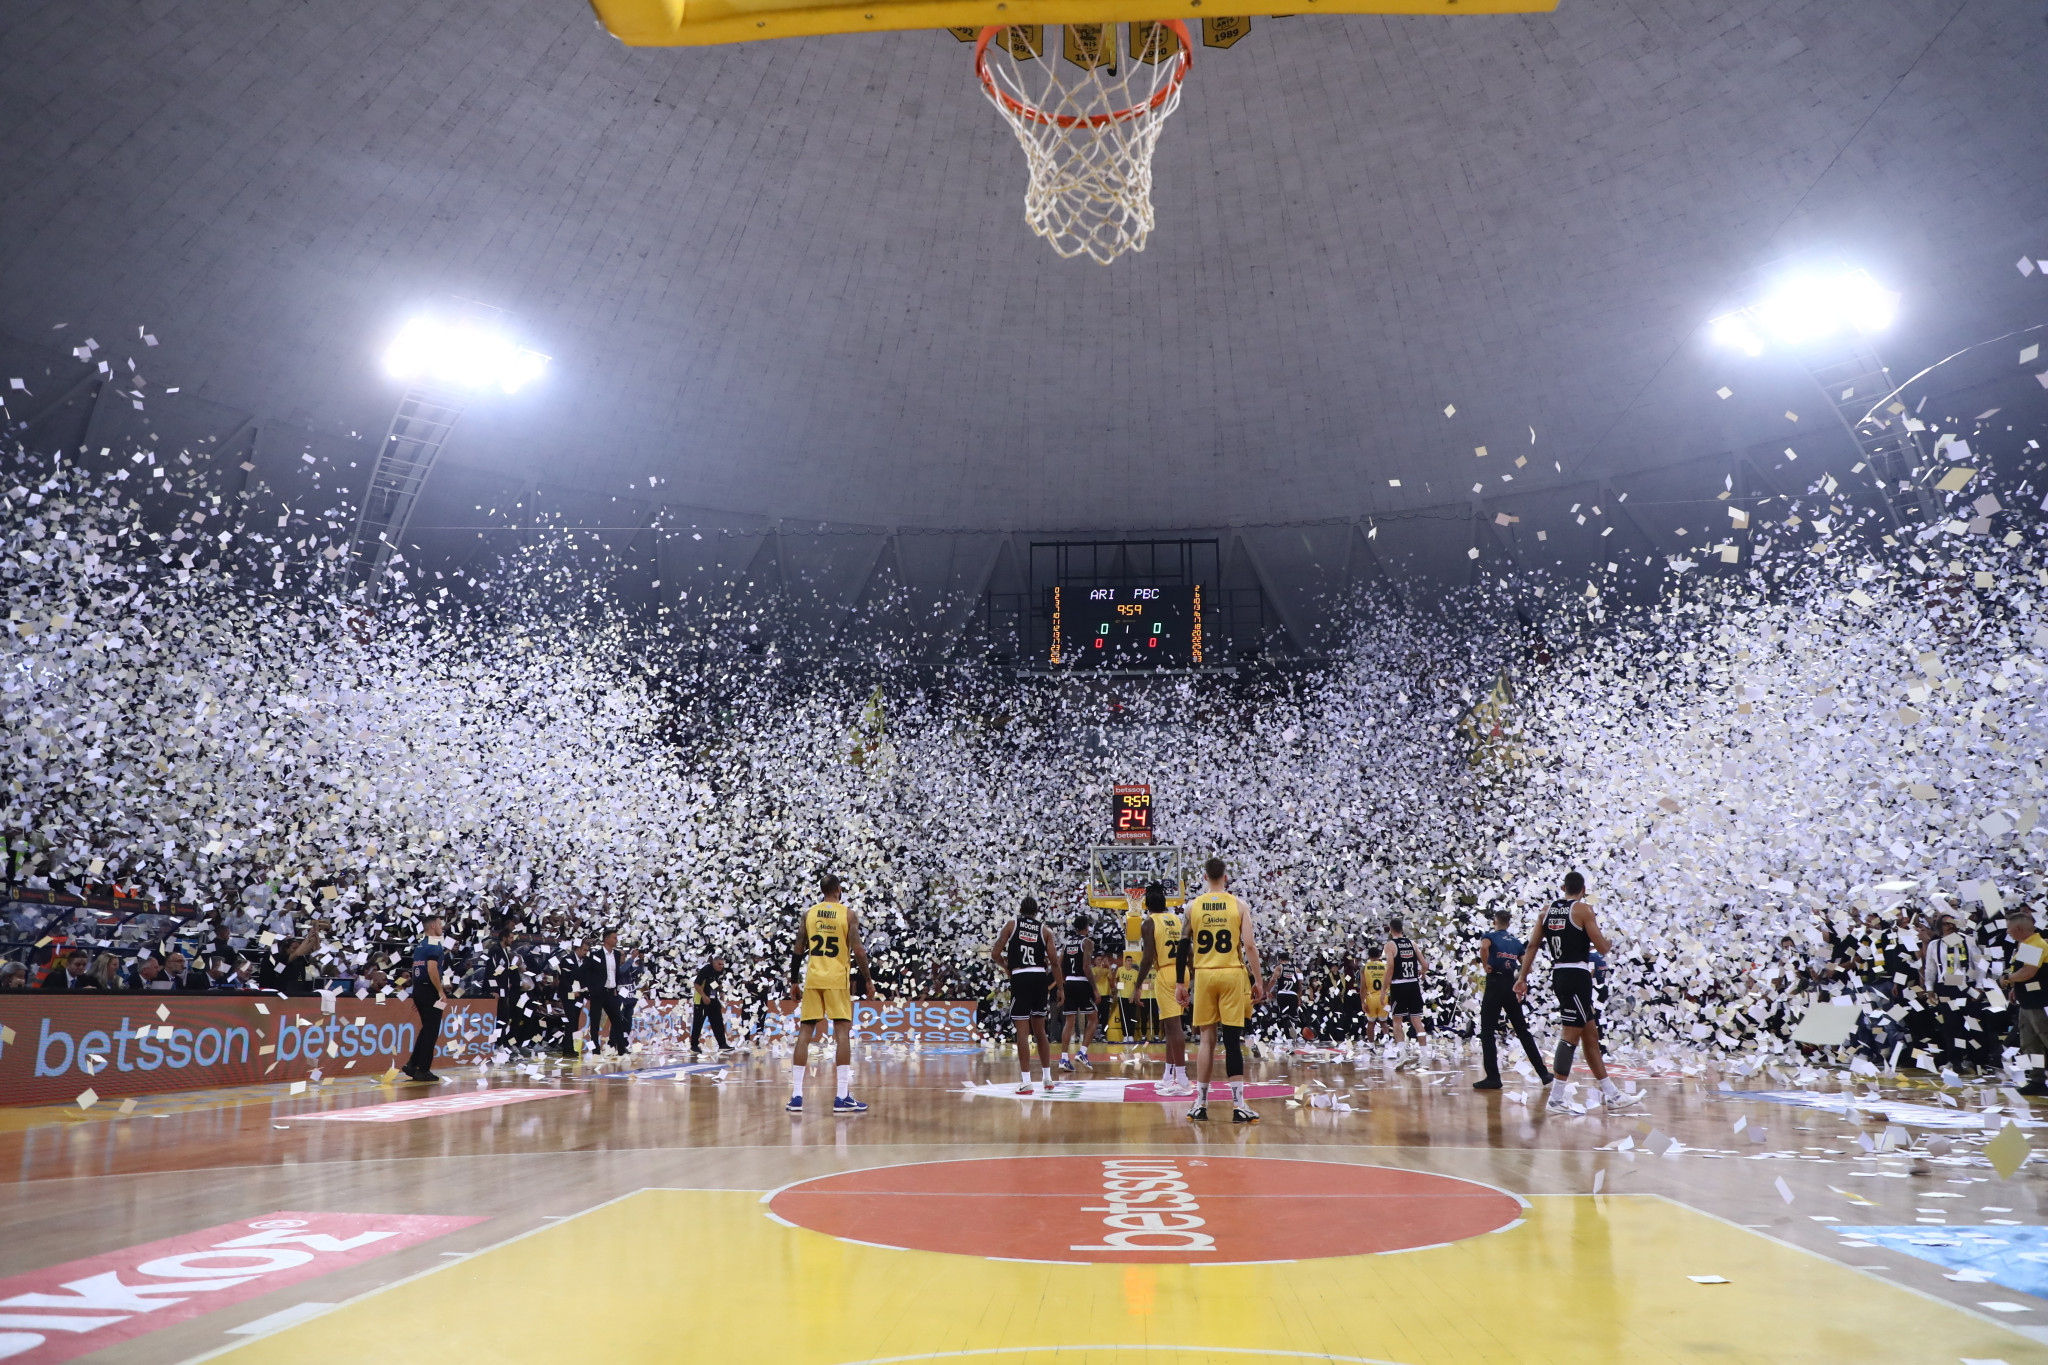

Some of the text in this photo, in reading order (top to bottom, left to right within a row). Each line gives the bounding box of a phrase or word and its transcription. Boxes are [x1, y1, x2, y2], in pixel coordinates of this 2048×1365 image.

[1214, 28, 1240, 43] 1989
[1089, 588, 1160, 600] ARI PBC
[1117, 604, 1142, 616] 9:59
[1100, 623, 1109, 635] 0
[1152, 622, 1162, 634] 0
[1095, 637, 1157, 649] 0 0
[1123, 795, 1150, 808] 9:59
[1119, 809, 1147, 828] 24
[1202, 902, 1227, 911] KULBOKA
[1019, 921, 1040, 932] MOORE
[1205, 916, 1228, 924] Midea
[810, 934, 840, 958] 25
[1197, 929, 1233, 955] 98
[1020, 945, 1037, 966] 26
[1069, 957, 1076, 974] 2
[1401, 961, 1415, 978] 33
[1372, 978, 1382, 991] 0
[852, 1002, 978, 1029] betss
[276, 1014, 415, 1062] betsson
[34, 1016, 249, 1078] betsson
[1070, 1159, 1218, 1251] betsson
